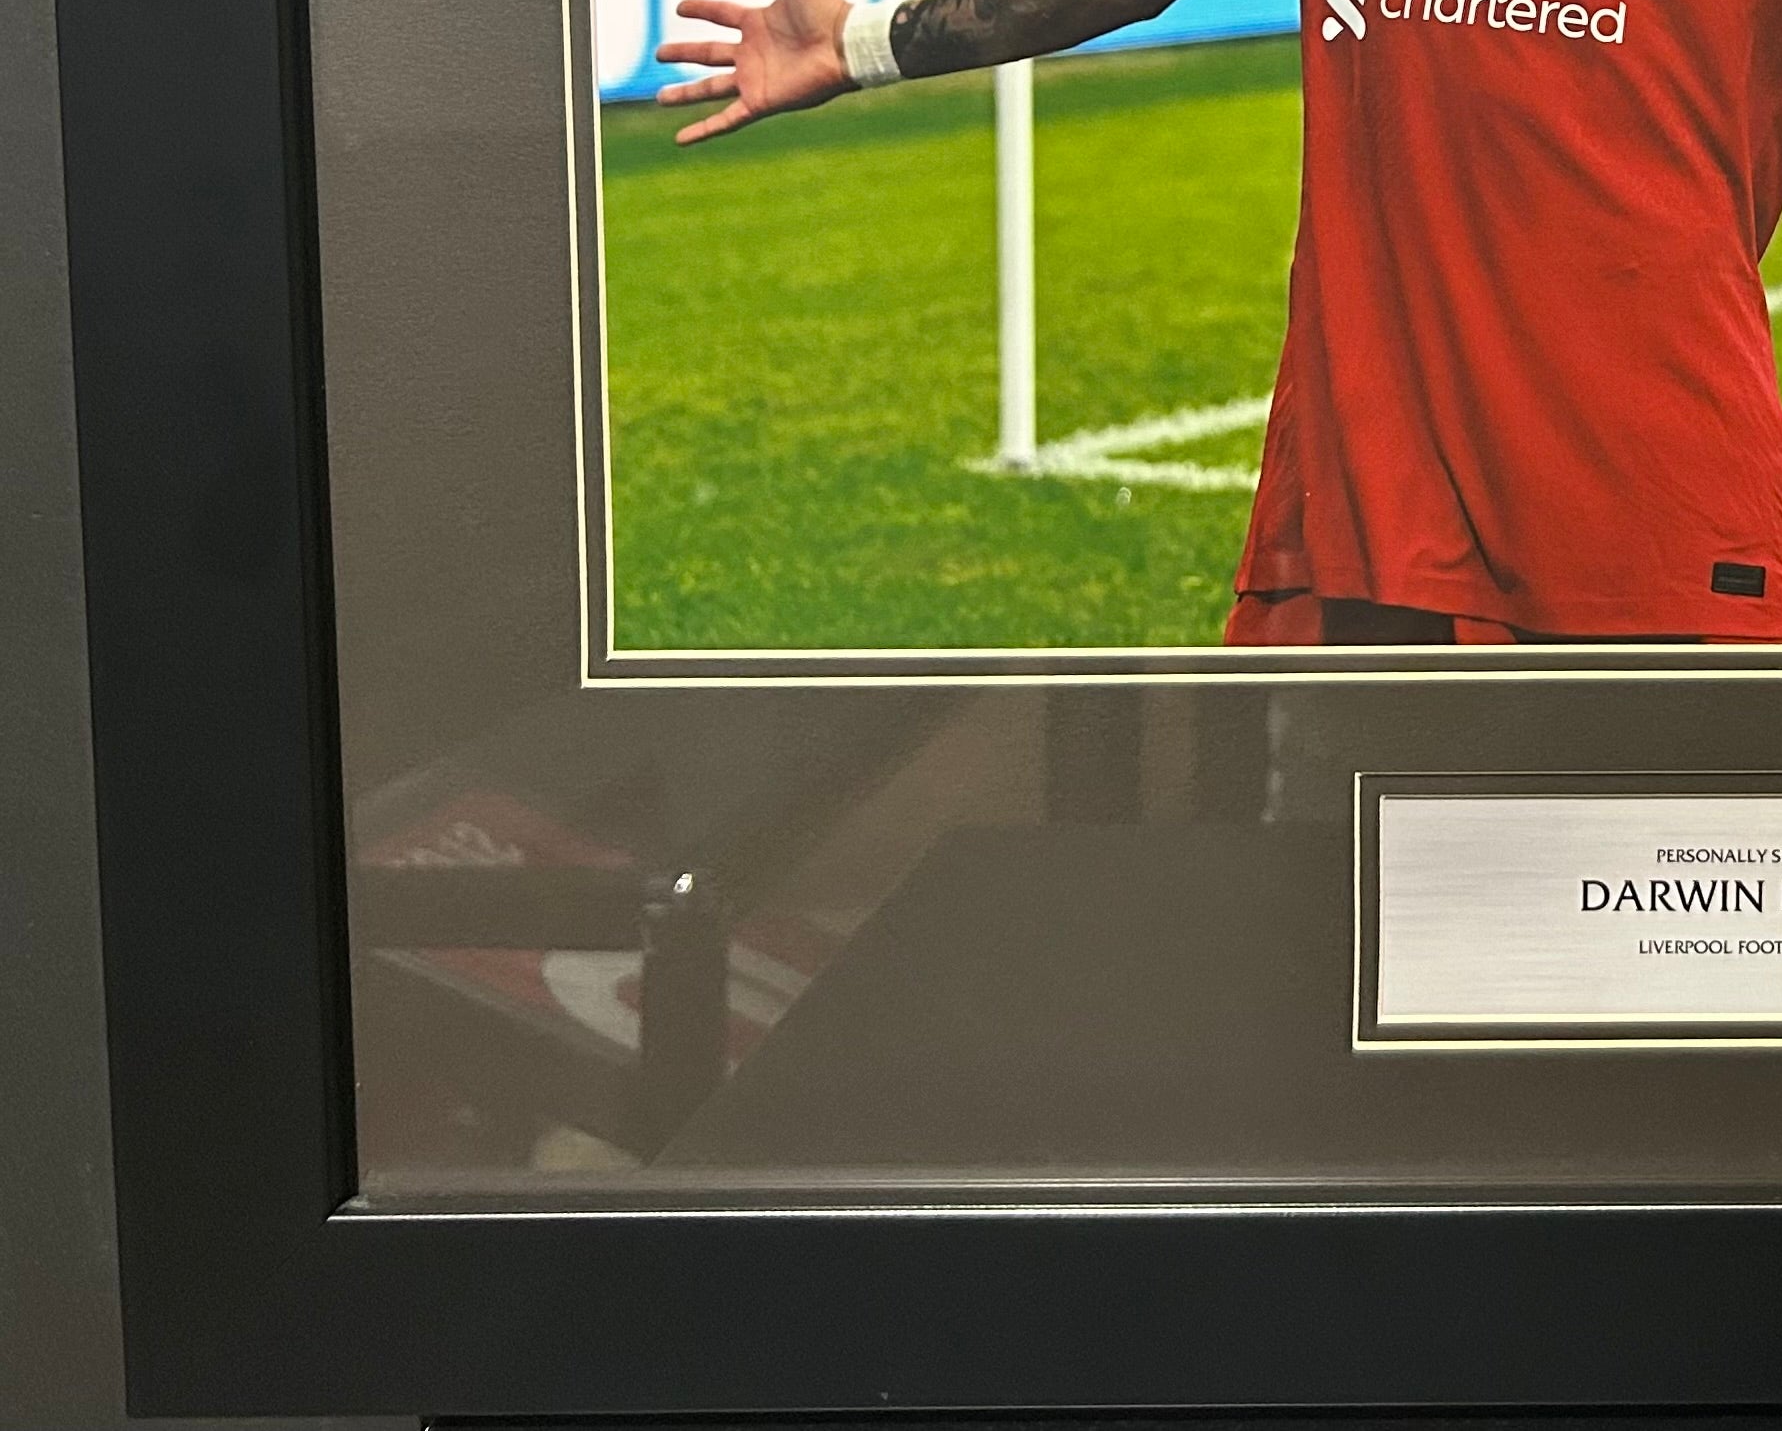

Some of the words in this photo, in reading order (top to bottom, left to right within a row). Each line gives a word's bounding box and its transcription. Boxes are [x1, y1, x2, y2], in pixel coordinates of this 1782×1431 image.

[1656, 848, 1768, 864] PERSONALLY
[1581, 880, 1763, 913] DARWIN
[1639, 940, 1733, 955] LIVERPOOL
